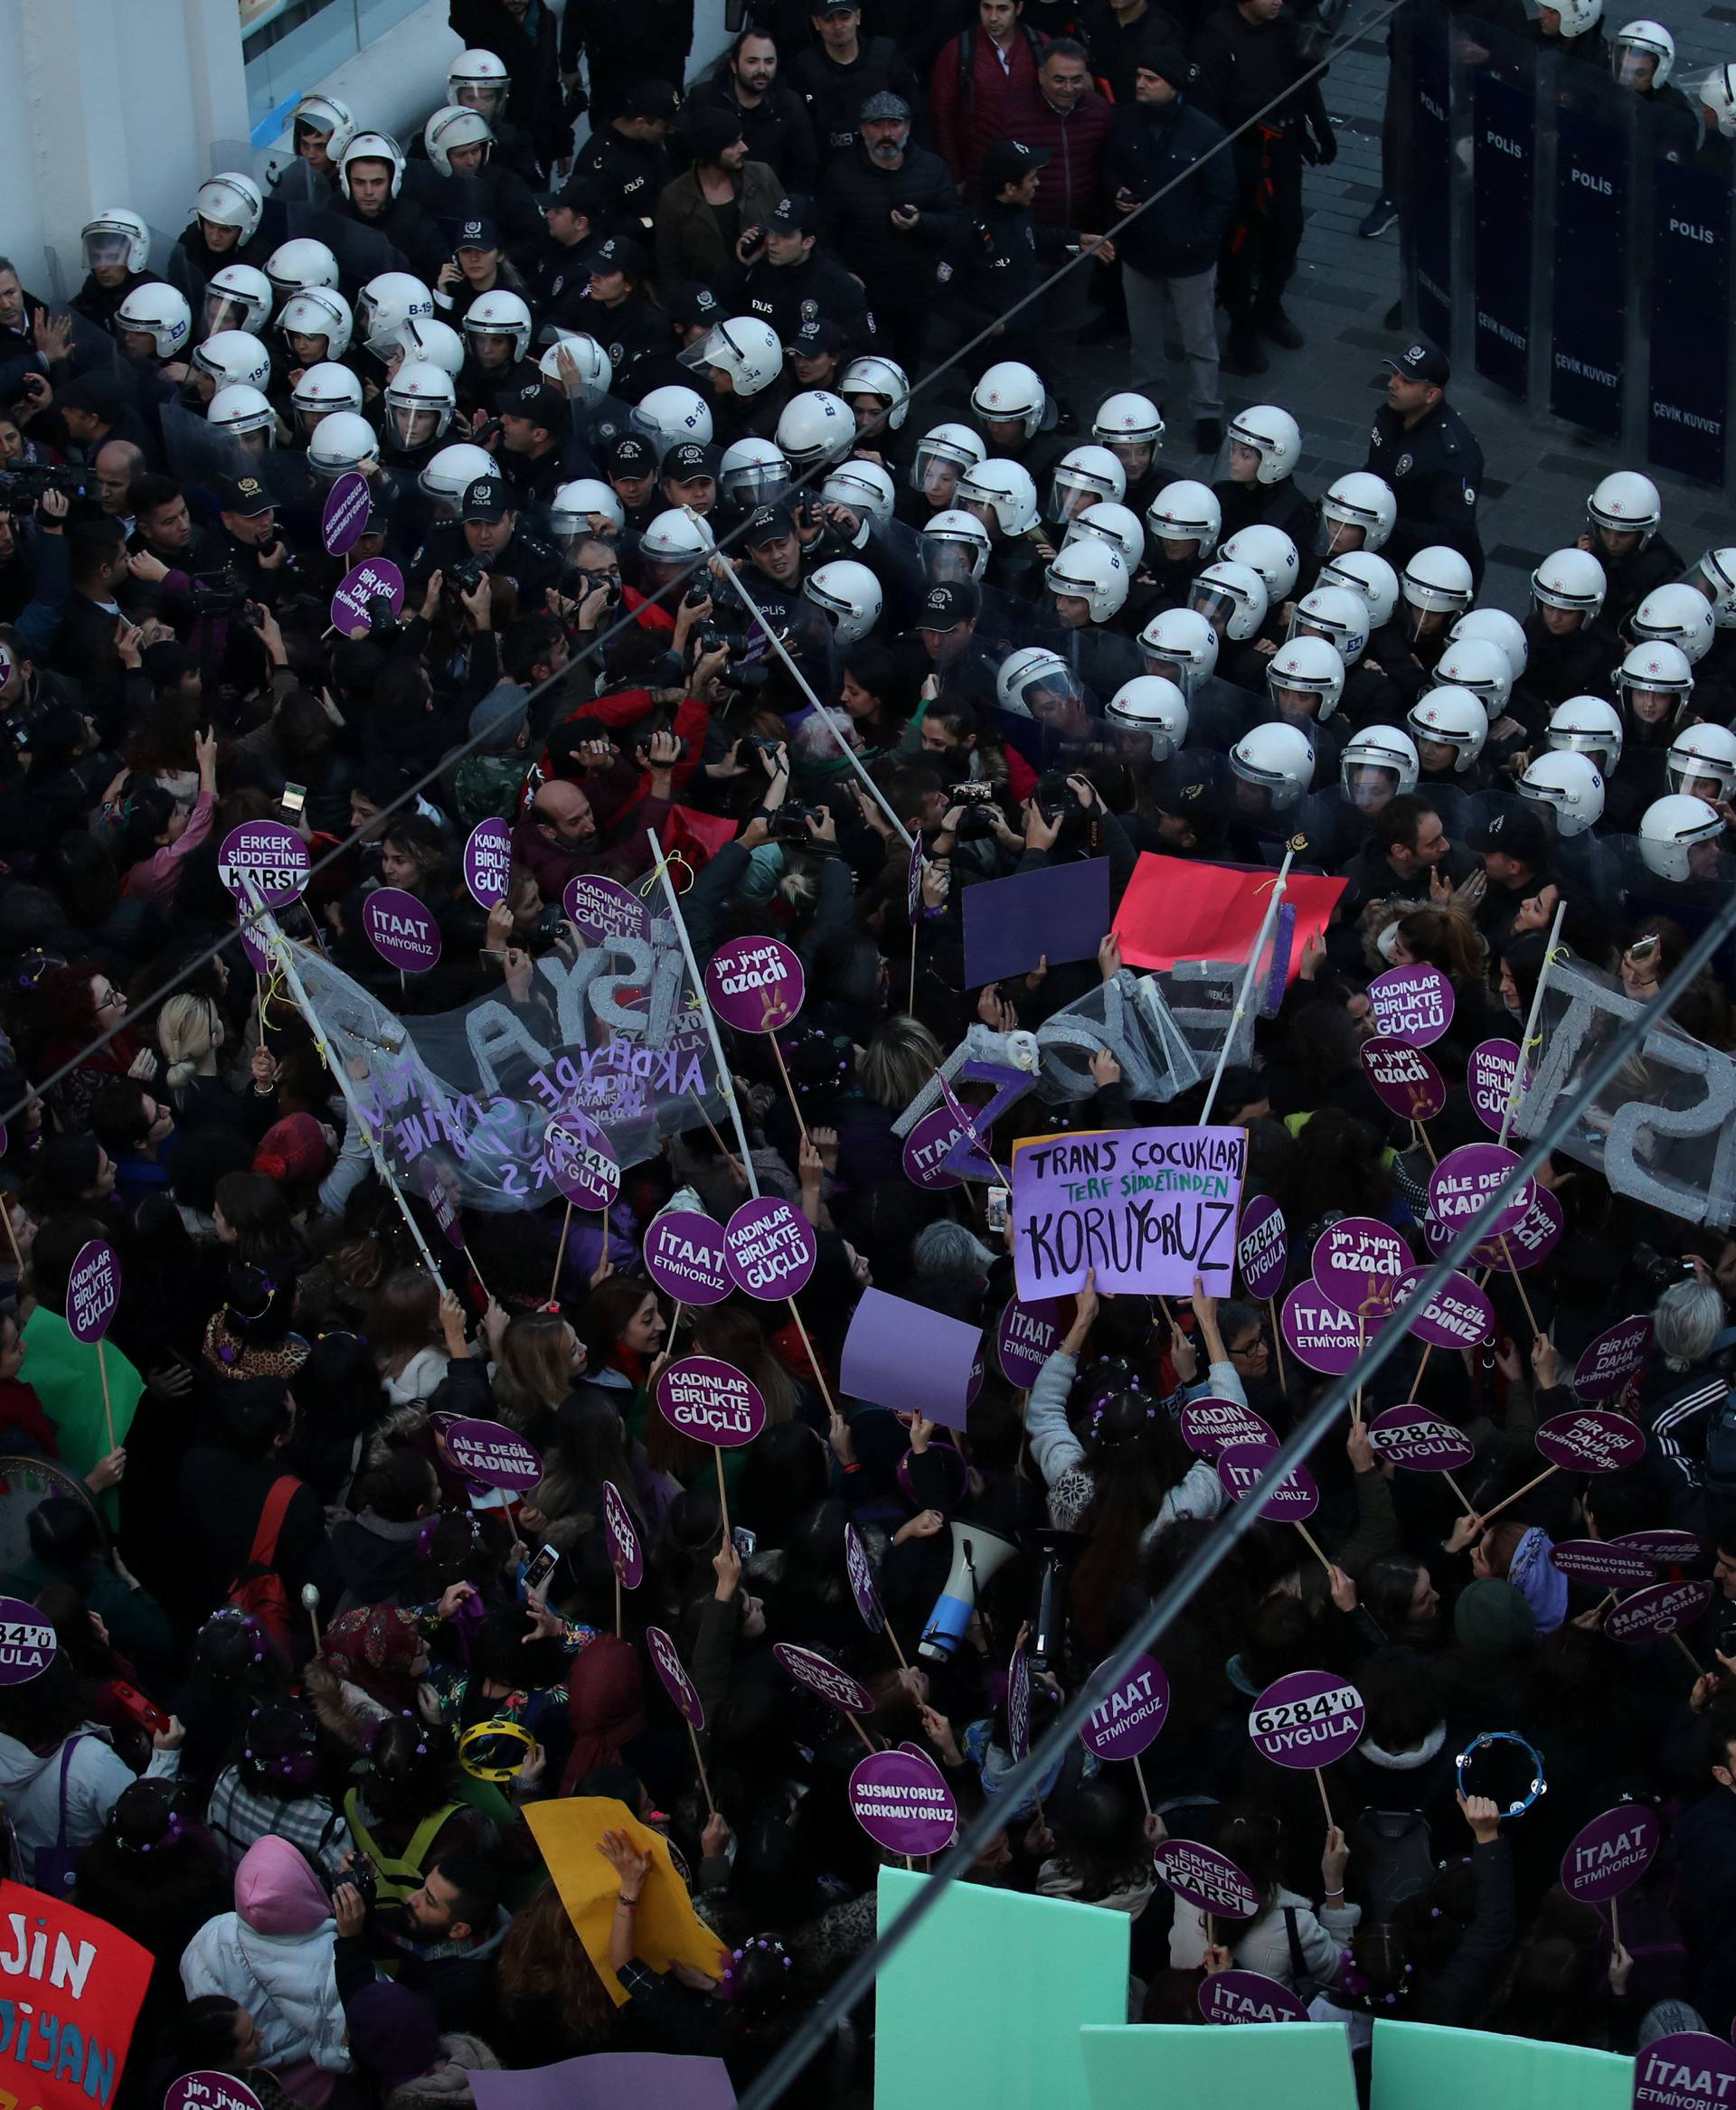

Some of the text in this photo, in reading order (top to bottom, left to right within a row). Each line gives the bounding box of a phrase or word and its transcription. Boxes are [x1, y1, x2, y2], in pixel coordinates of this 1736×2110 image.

[1486, 129, 1524, 159] POLİS
[1571, 167, 1613, 197] POLİS
[1669, 217, 1715, 245] POLİS
[1555, 352, 1619, 390] ÇEVİK KUVVET
[1653, 400, 1722, 436] ÇEVİK KUVVET
[358, 568, 378, 589] BİR
[227, 848, 307, 866] ŞİDDETİNE
[240, 835, 293, 850] ERKEK
[575, 892, 643, 930] BİRLİKTE
[576, 880, 644, 918] KADINLAR
[372, 905, 429, 940] İTAAT
[373, 931, 435, 956] ETMİYORUZ
[712, 945, 779, 979] jin jiyan
[722, 955, 788, 995] azadi
[1371, 975, 1441, 1000] KADINLAR
[1373, 990, 1443, 1016] BİRLİKTE
[1376, 1005, 1445, 1035] GÜÇLÜ
[1363, 1049, 1419, 1068] jin jiyan
[1373, 1060, 1429, 1084] azadi
[1029, 1135, 1246, 1181] TRANS ÇOCUKLARI
[1060, 1175, 1115, 1204] TERF
[1436, 1174, 1474, 1196] AİLE
[726, 1205, 794, 1250] KADINLAR
[1022, 1199, 1235, 1280] KORUYORUZ
[1241, 1214, 1284, 1265] 6284'Ü
[1328, 1228, 1354, 1251] jin
[1355, 1230, 1401, 1256] jiyan
[657, 1225, 724, 1274] İTAAT
[734, 1221, 802, 1269] BİRLİKTE
[71, 1249, 111, 1293] KADINLAR
[653, 1254, 725, 1291] ETMİYORUZ
[746, 1239, 811, 1289] GÜÇLÜ
[1246, 1239, 1287, 1286] UYGULA
[1330, 1249, 1402, 1276] azadi
[73, 1266, 113, 1311] BİRLİKTE
[76, 1283, 115, 1333] GÜÇLÜ
[1441, 1295, 1488, 1328] DEĞİL
[1009, 1305, 1055, 1349] İTAAT
[1595, 1350, 1634, 1371] DAHA
[1596, 1337, 1622, 1357] BİR
[667, 1372, 750, 1394] KADINLAR
[670, 1385, 750, 1412] BİRLİKTE
[674, 1403, 752, 1433] GÜÇLÜ
[1185, 1406, 1248, 1425] KADIN
[1187, 1420, 1263, 1436] DAYANIŞMASI
[453, 1436, 534, 1459] AİLE DEĞİL
[1374, 1423, 1463, 1446] 6284'Ü
[1565, 1428, 1610, 1455] DAHA
[1572, 1417, 1636, 1450] BİR KİŞİ
[456, 1450, 540, 1476] KADINIZ
[1385, 1439, 1472, 1461] UYGULA
[1554, 1559, 1655, 1578] KORKMUYORUZ
[1555, 1551, 1646, 1569] SUSMUYORUZ
[1611, 1584, 1698, 1629] HAYATI
[1095, 1696, 1164, 1747] ETMİYORUZ
[1255, 1691, 1356, 1733] 6284'Ü
[1264, 1715, 1360, 1754] UYGULA
[856, 1783, 946, 1802] SUSMUYORUZ
[854, 1802, 955, 1823] KORKMUYORUZ
[1576, 1823, 1646, 1873] İTAAT
[1164, 1851, 1254, 1900] ŞİDDETİNE
[1178, 1847, 1239, 1882] ERKEK
[1573, 1847, 1648, 1889] ETMİYORUZ
[1213, 1982, 1297, 2024] İTAAT
[183, 2077, 211, 2099] jin
[1644, 2052, 1736, 2098] İTAAT
